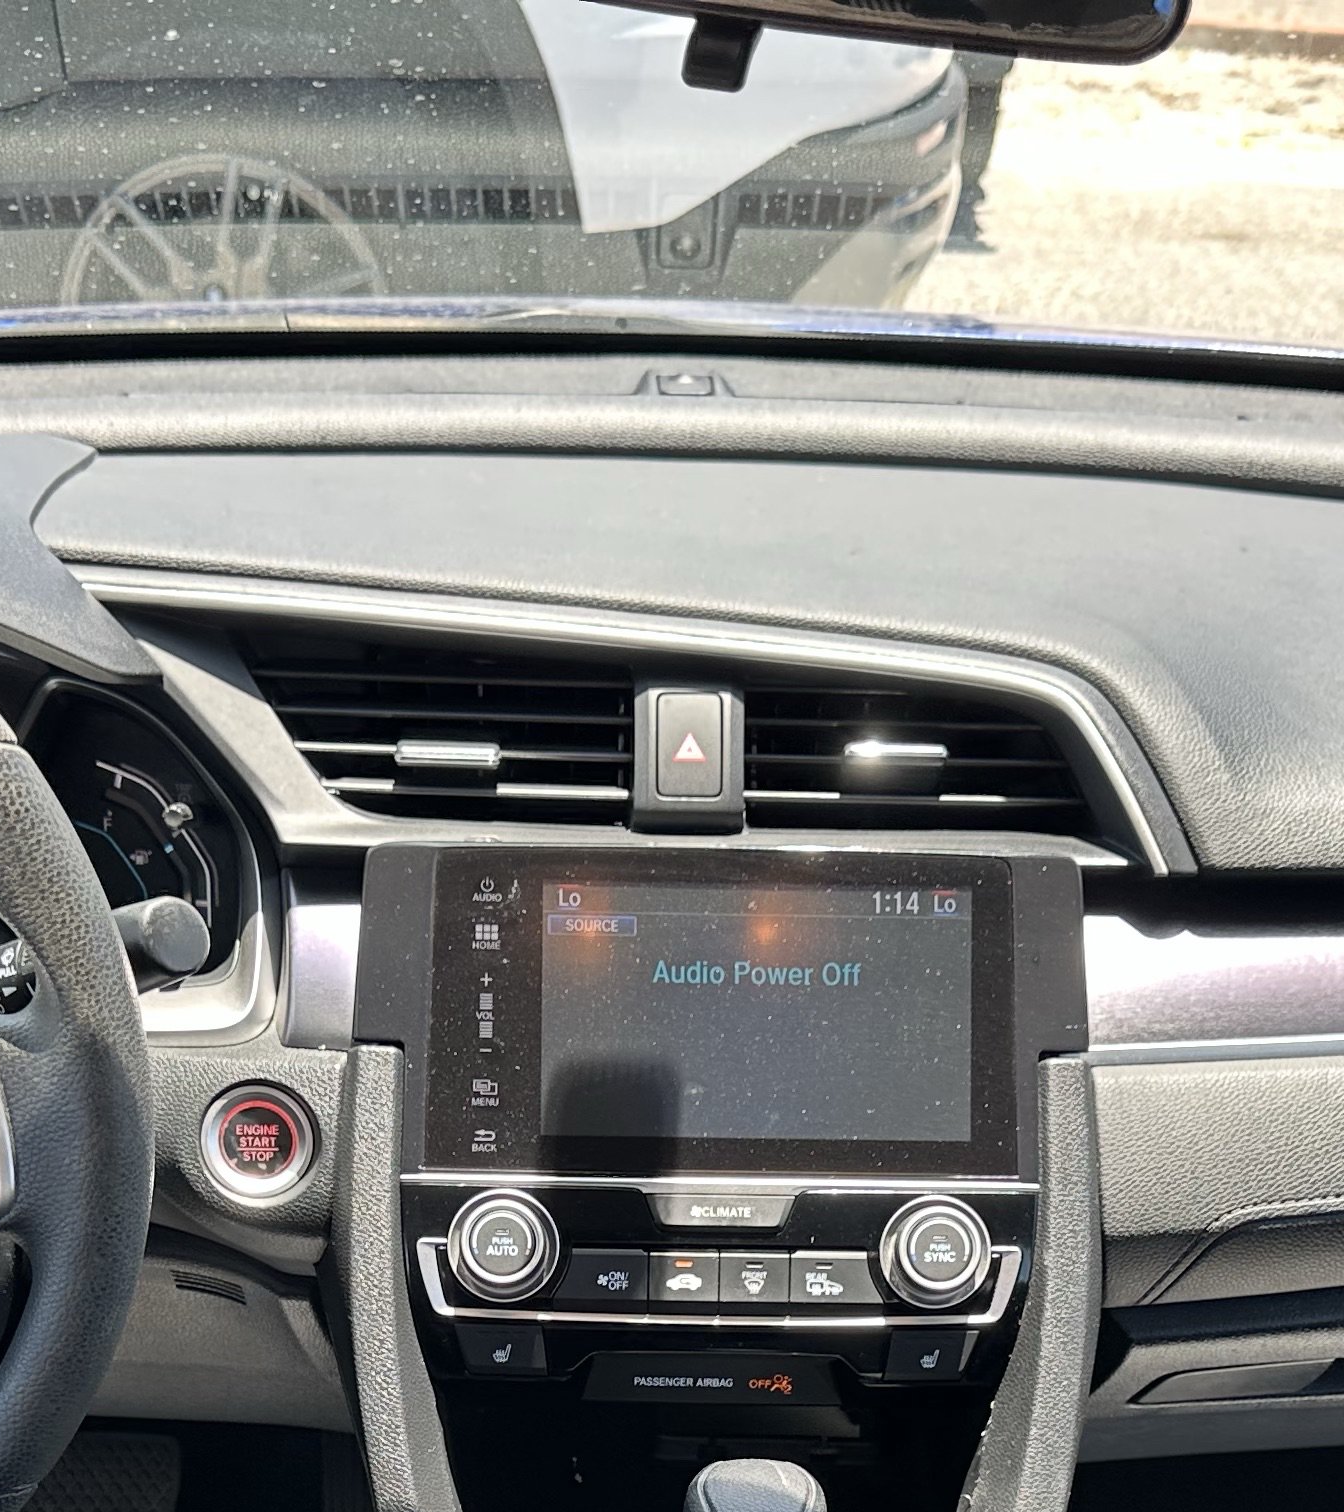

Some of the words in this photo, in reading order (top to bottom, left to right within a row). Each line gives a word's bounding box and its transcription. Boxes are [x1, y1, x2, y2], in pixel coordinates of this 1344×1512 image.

[472, 892, 503, 902] AUDIO
[557, 888, 581, 907] Lo
[872, 891, 920, 914] 1:14
[933, 894, 956, 913] Lo
[565, 918, 619, 933] SOURCE
[472, 940, 501, 950] HOME
[652, 960, 725, 984] Audio
[734, 963, 814, 986] Power
[822, 961, 862, 986] Off
[476, 1011, 495, 1021] VOL
[471, 1097, 500, 1107] MENU
[236, 1124, 279, 1136] ENGINE
[239, 1136, 276, 1147] START
[471, 1143, 498, 1153] BACK
[243, 1151, 274, 1162] STOP
[701, 1207, 751, 1218] CLIMATE
[492, 1237, 513, 1245] PUSH
[486, 1245, 519, 1257] AUTO
[929, 1243, 951, 1251] PUSH
[923, 1251, 956, 1263] SYNC
[608, 1280, 629, 1291] OFF
[634, 1376, 694, 1387] PASSENGER
[696, 1378, 734, 1388] AIRBAG
[748, 1379, 772, 1389] OFF
